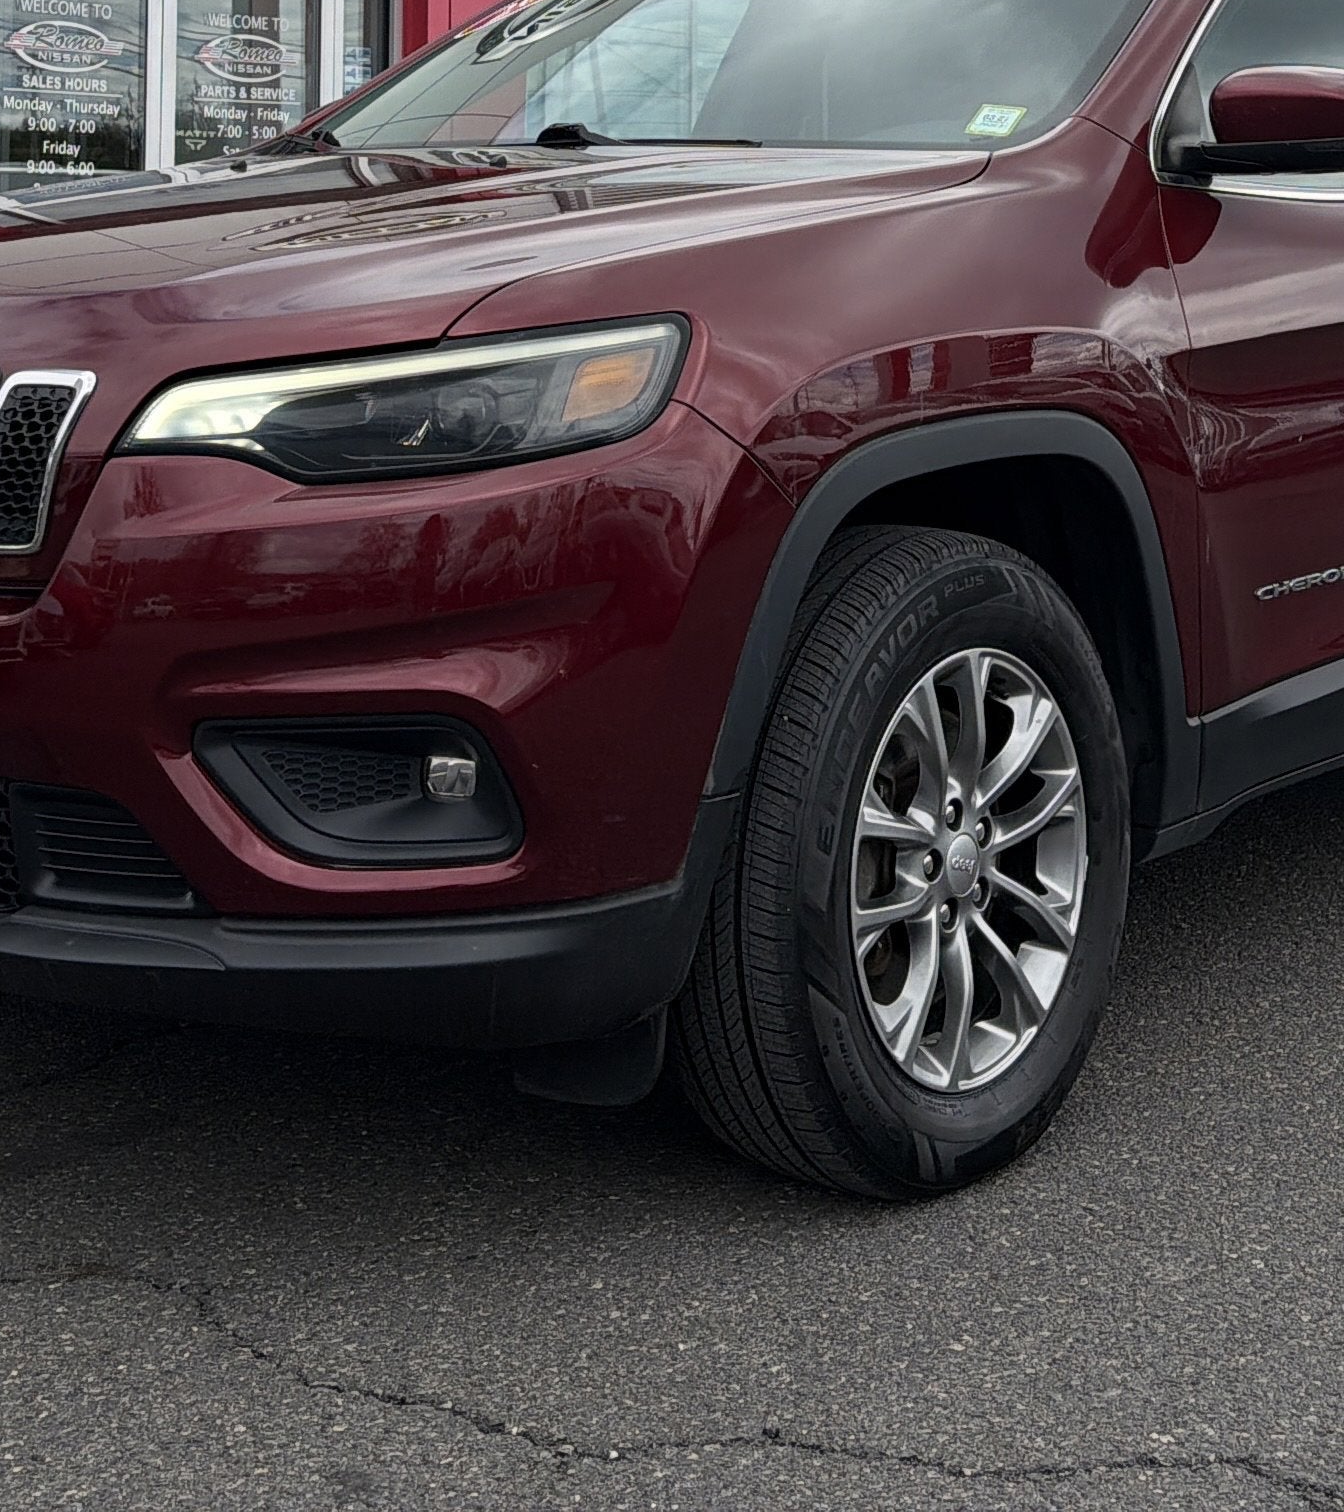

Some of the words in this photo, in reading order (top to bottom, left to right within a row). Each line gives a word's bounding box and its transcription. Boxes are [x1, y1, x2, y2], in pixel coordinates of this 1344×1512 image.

[94, 3, 112, 20] TO
[208, 13, 269, 31] WELCOME
[272, 17, 289, 32] TO
[27, 23, 105, 51] Romeo
[38, 51, 92, 65] NISSAN
[215, 37, 284, 62] Romeo
[224, 64, 272, 75] NISSAN
[22, 74, 61, 89] SALES
[65, 78, 107, 93] HOURS
[201, 85, 236, 99] PARTS
[239, 86, 247, 99] &
[250, 87, 296, 101] SERVICE
[3, 95, 53, 112] Monday
[64, 99, 121, 117] Thursday
[204, 105, 248, 122] Monday
[257, 108, 290, 123] Friday
[27, 117, 56, 132] 9:00
[68, 119, 96, 134] 7:00
[217, 124, 242, 139] 7:00
[252, 126, 277, 139] 5:00
[43, 140, 81, 158] Friday
[26, 160, 55, 175] 9:00
[67, 161, 95, 176] 6:00
[944, 574, 985, 598] PLUS
